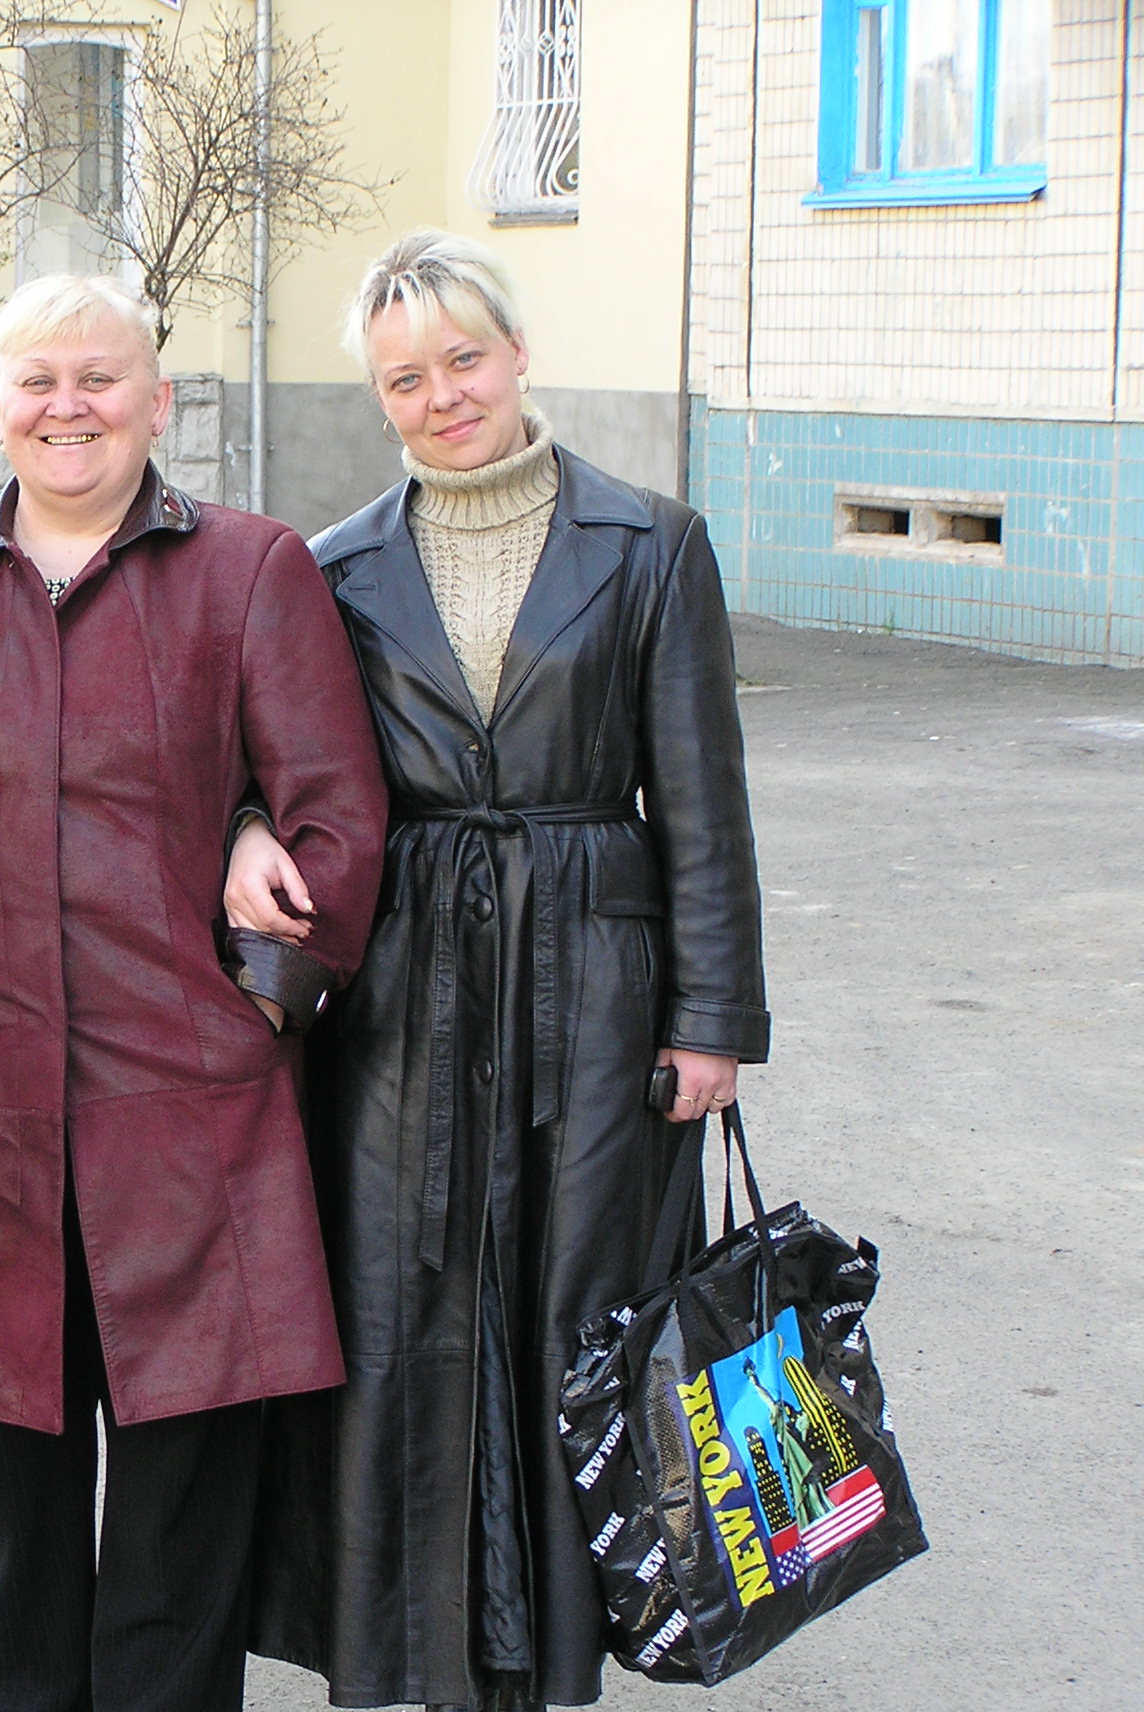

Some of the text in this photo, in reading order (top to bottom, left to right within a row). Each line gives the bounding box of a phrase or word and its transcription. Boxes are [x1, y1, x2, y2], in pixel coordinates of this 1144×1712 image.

[823, 1300, 866, 1325] YORK
[574, 1452, 606, 1491] NEW
[676, 1369, 775, 1608] NEW YORK
[590, 1511, 626, 1556] YORK
[635, 1545, 667, 1584] NEW
[652, 1608, 690, 1650] YORK
